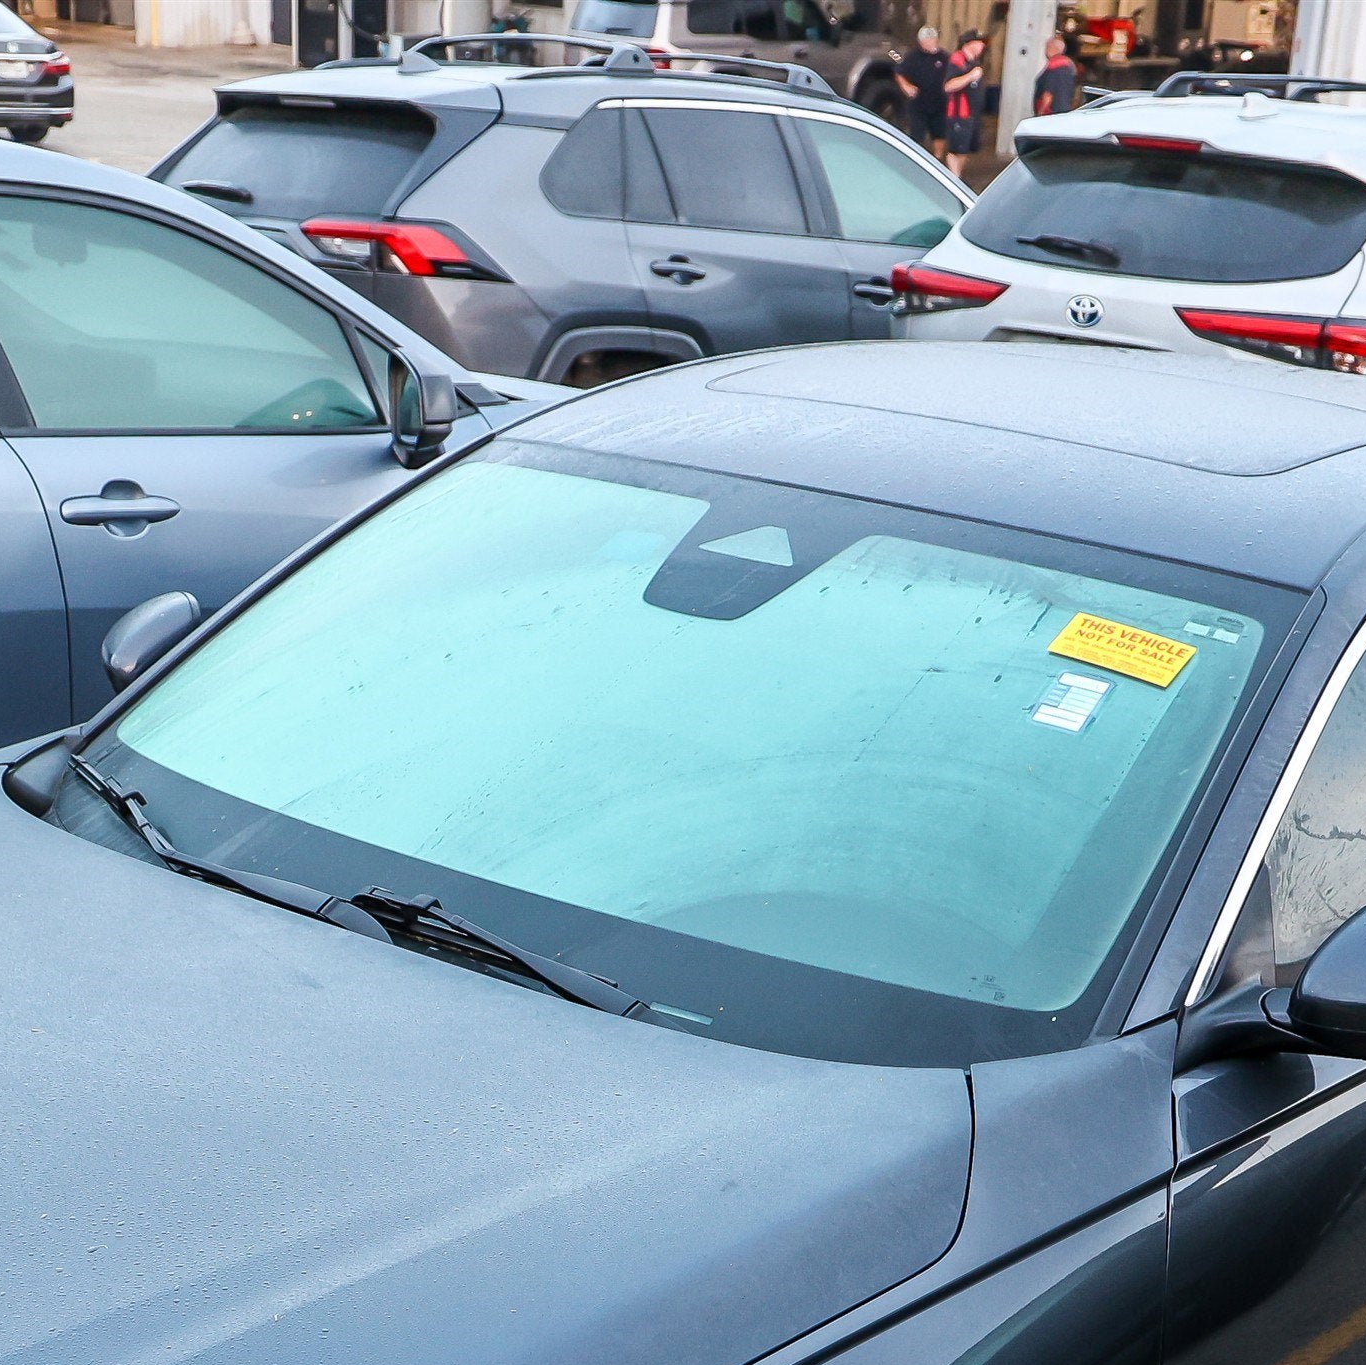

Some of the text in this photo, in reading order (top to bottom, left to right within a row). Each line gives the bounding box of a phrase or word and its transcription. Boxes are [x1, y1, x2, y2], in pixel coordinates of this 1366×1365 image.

[1075, 629, 1177, 665] NOT FOR SALE
[1080, 618, 1116, 635] THIS
[1120, 629, 1189, 659] VEHICLE
